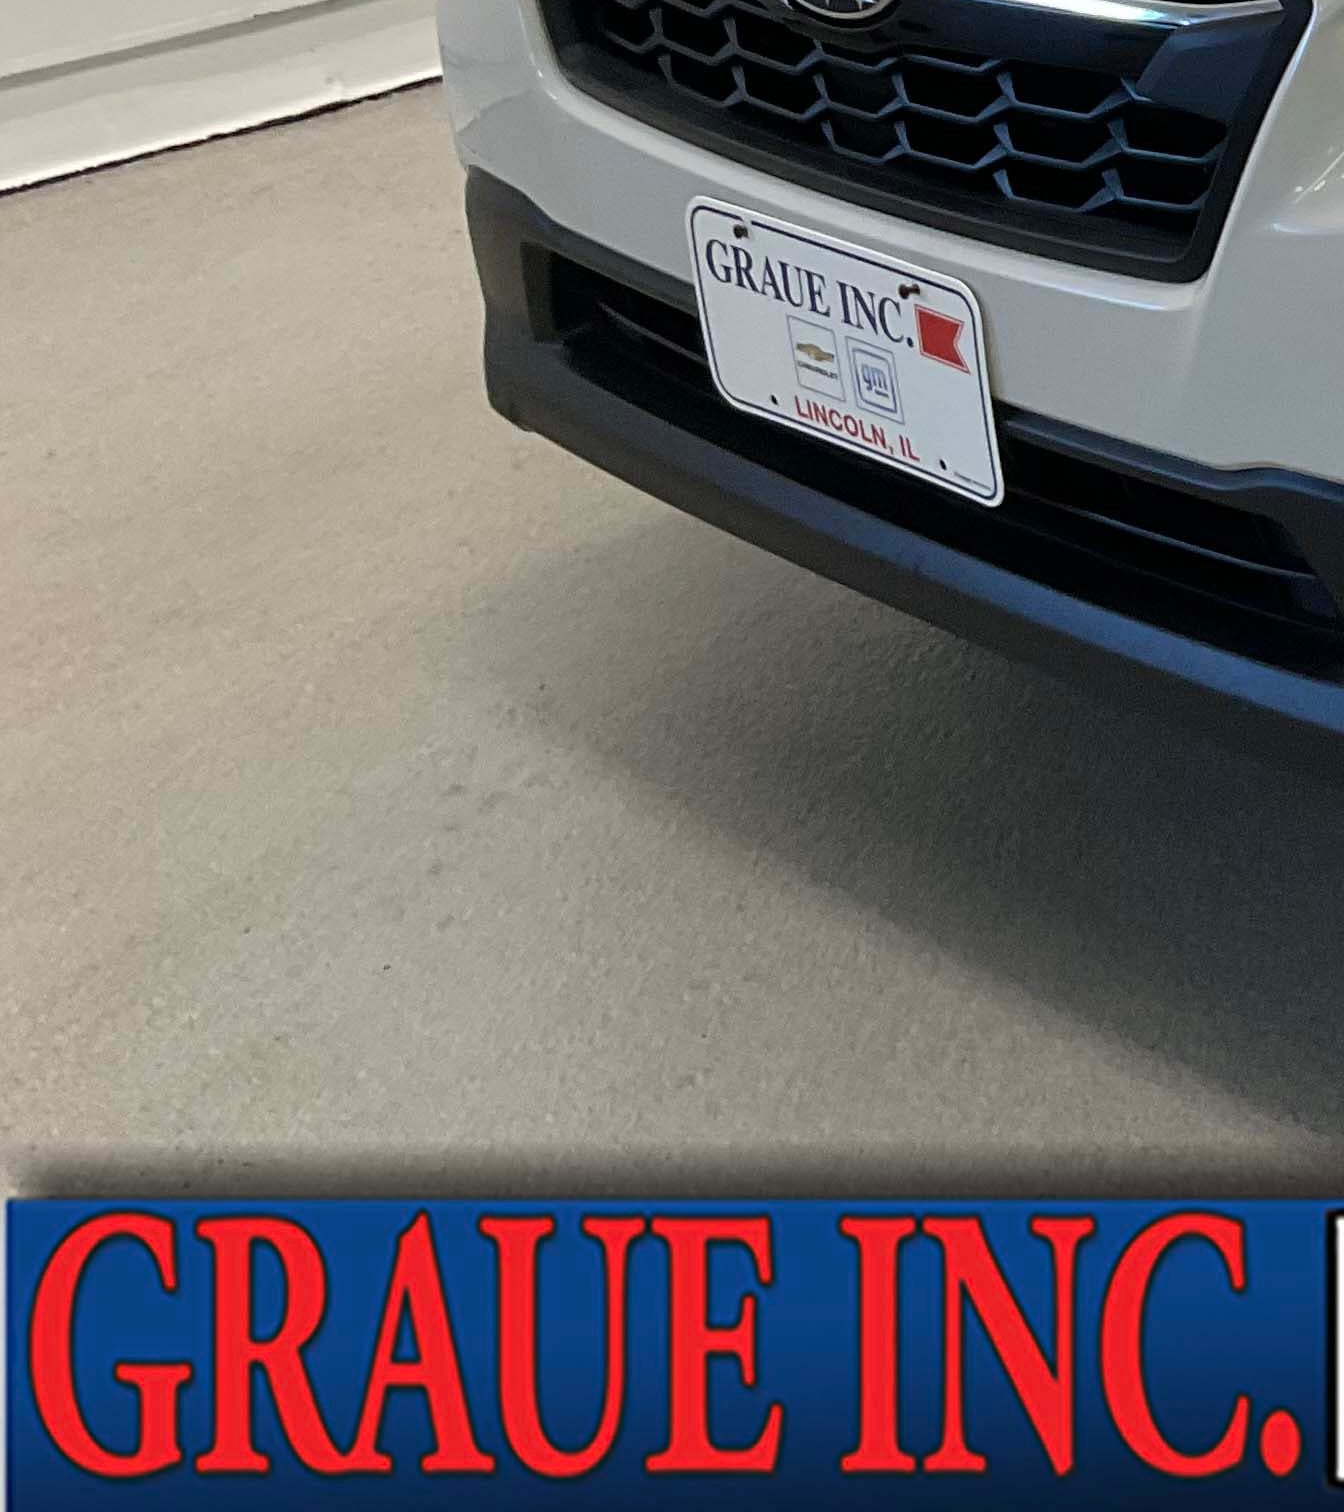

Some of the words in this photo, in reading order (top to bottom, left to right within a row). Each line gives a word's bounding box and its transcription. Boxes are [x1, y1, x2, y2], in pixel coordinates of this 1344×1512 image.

[706, 239, 831, 318] GRAUE
[836, 280, 915, 348] INC.
[794, 395, 895, 455] LINCOLN,
[899, 434, 921, 462] IL
